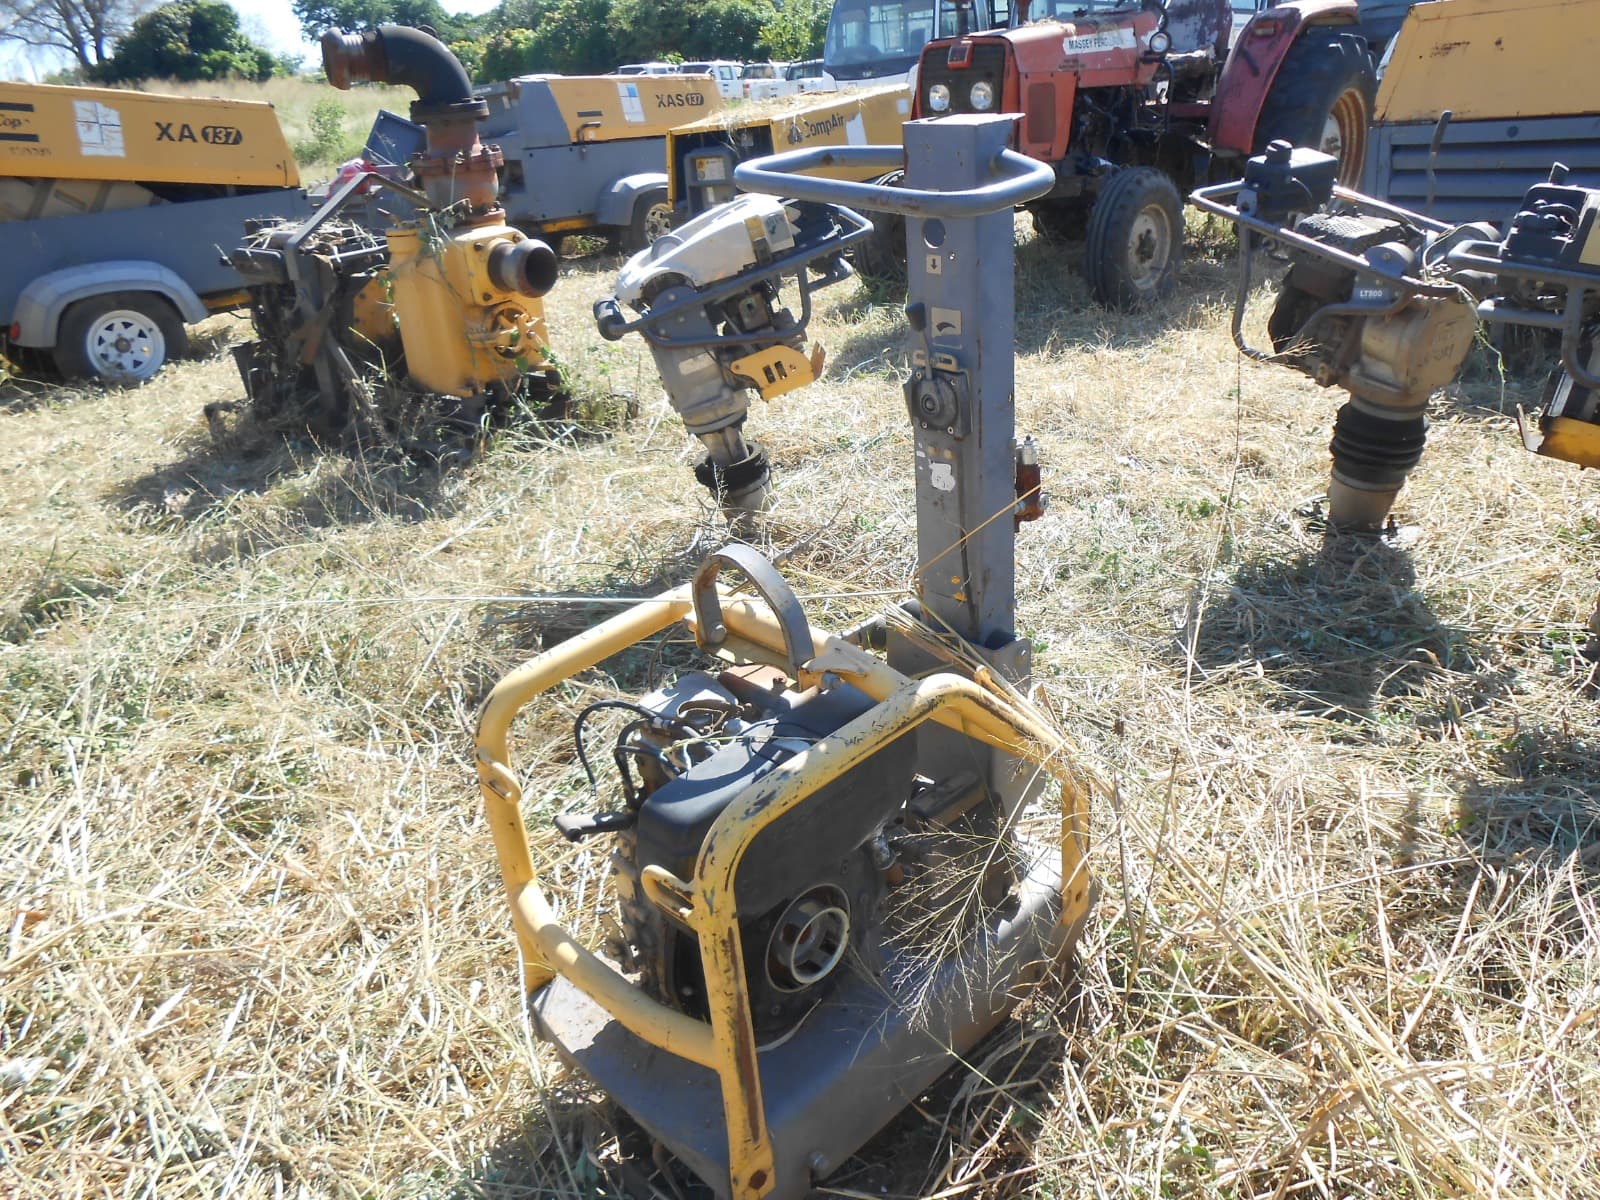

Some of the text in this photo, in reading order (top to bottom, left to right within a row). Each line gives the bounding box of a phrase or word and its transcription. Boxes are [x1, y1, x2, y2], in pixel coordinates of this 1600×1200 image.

[1068, 38, 1092, 50] MASSEY
[655, 93, 704, 108] XAS 137
[155, 121, 240, 144] XA 137
[803, 112, 844, 138] CompAir
